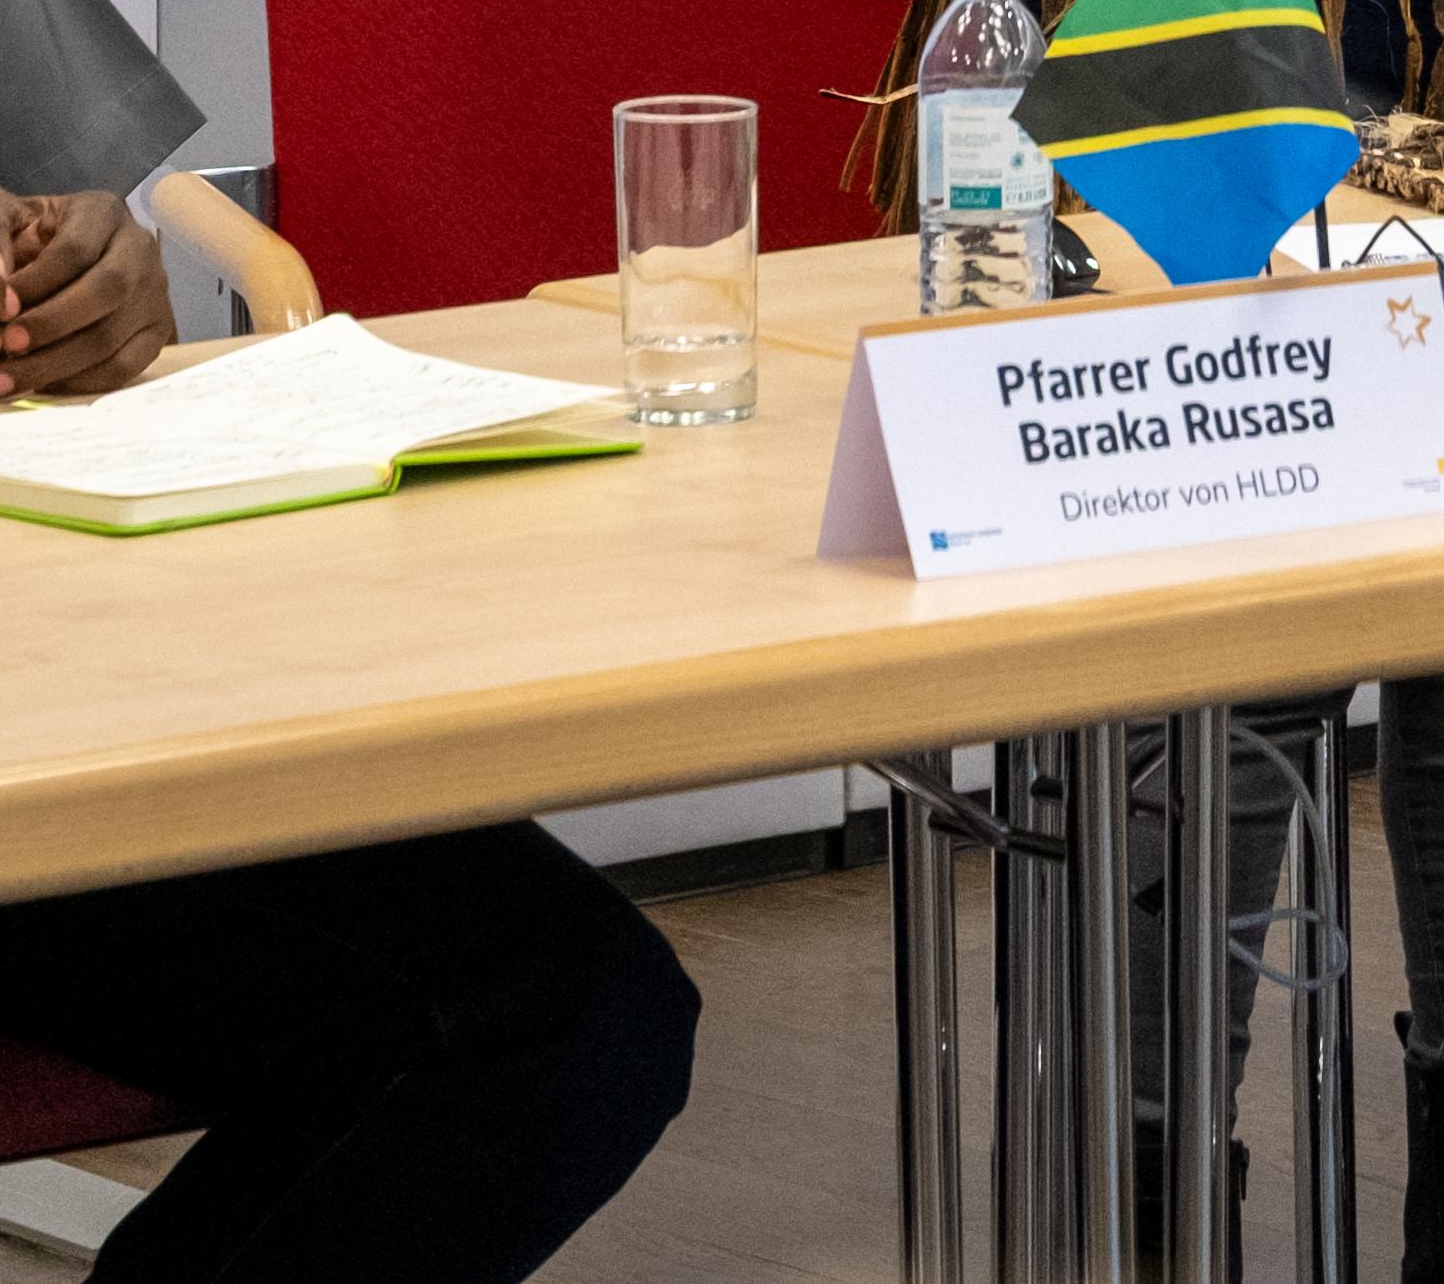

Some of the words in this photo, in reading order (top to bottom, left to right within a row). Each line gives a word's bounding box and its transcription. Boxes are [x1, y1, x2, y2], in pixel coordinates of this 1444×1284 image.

[997, 350, 1151, 408] Pfarrer
[1165, 334, 1334, 388] Godfrey
[1018, 412, 1171, 465] Baraka
[1183, 395, 1335, 445] Rusasa
[1060, 484, 1170, 522] Direktor
[1180, 480, 1230, 507] von
[1235, 463, 1321, 501] HLDD
